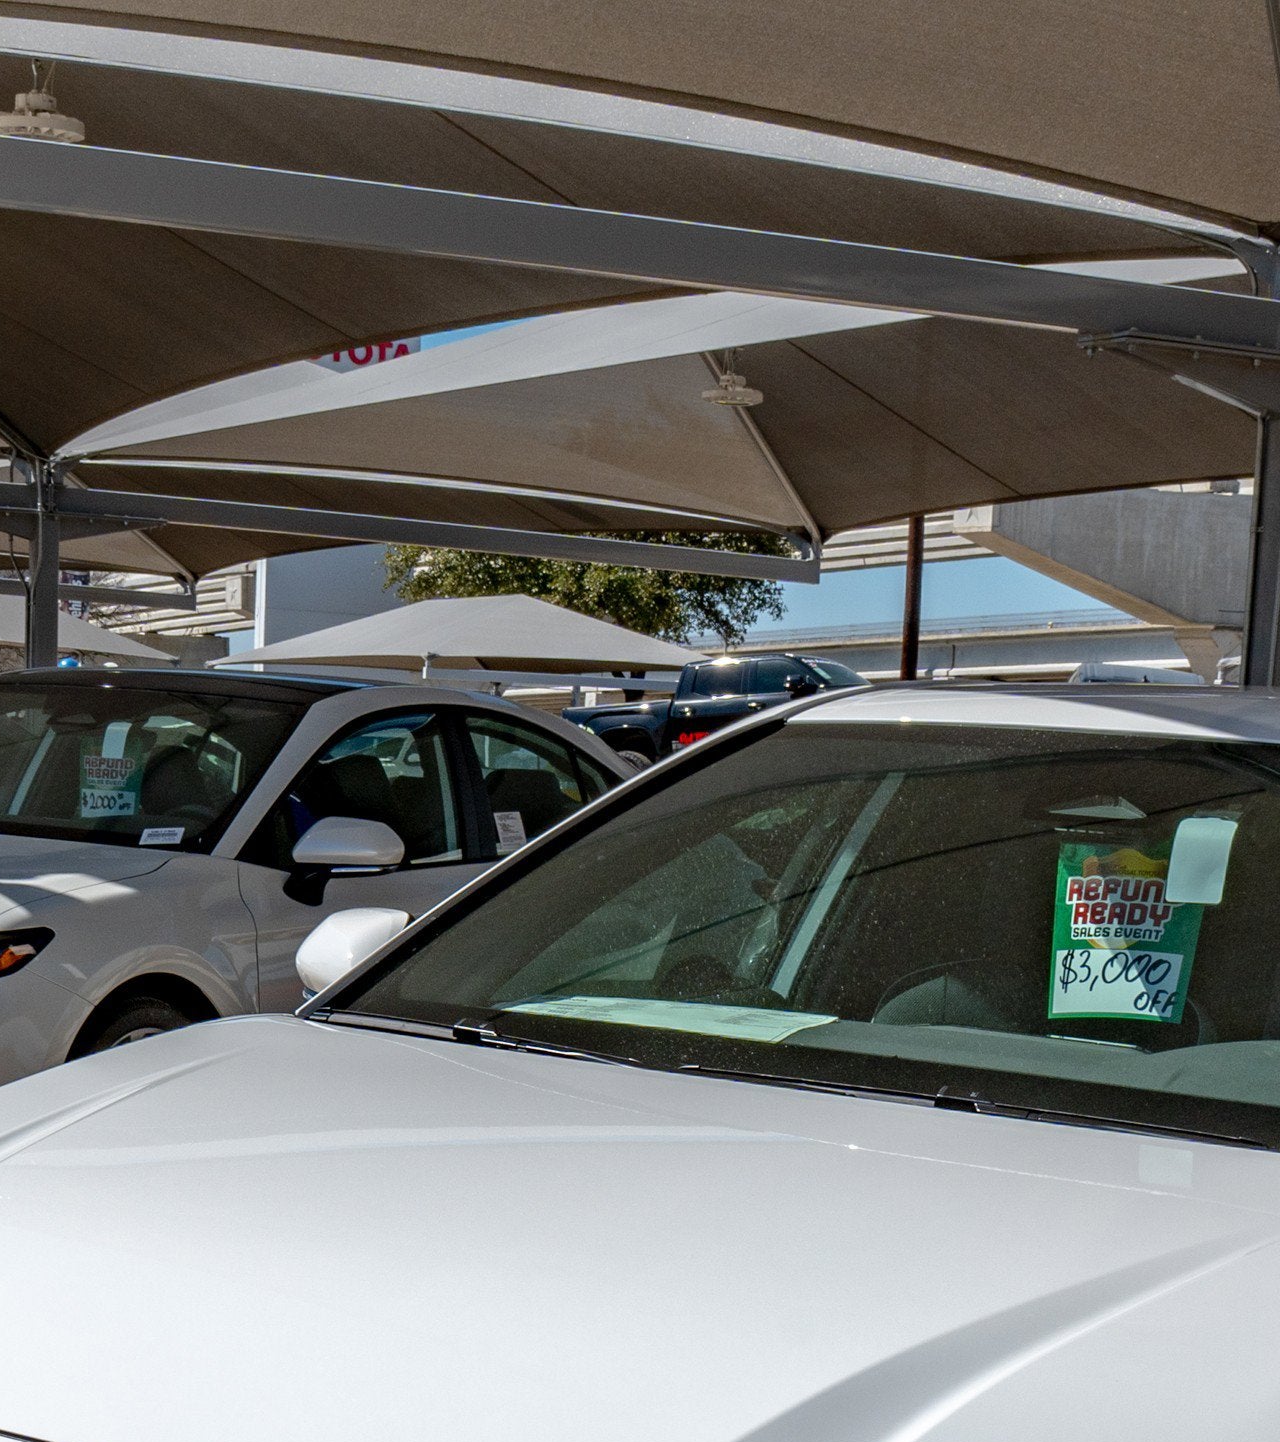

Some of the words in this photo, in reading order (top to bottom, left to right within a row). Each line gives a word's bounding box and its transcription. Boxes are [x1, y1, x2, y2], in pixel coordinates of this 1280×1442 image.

[1068, 878, 1166, 902] REFUN
[1073, 903, 1171, 927] READY
[1072, 926, 1110, 938] SALES
[1114, 927, 1162, 940] EVENT
[1059, 949, 1172, 993] $3,000
[1133, 989, 1181, 1013] OFF
